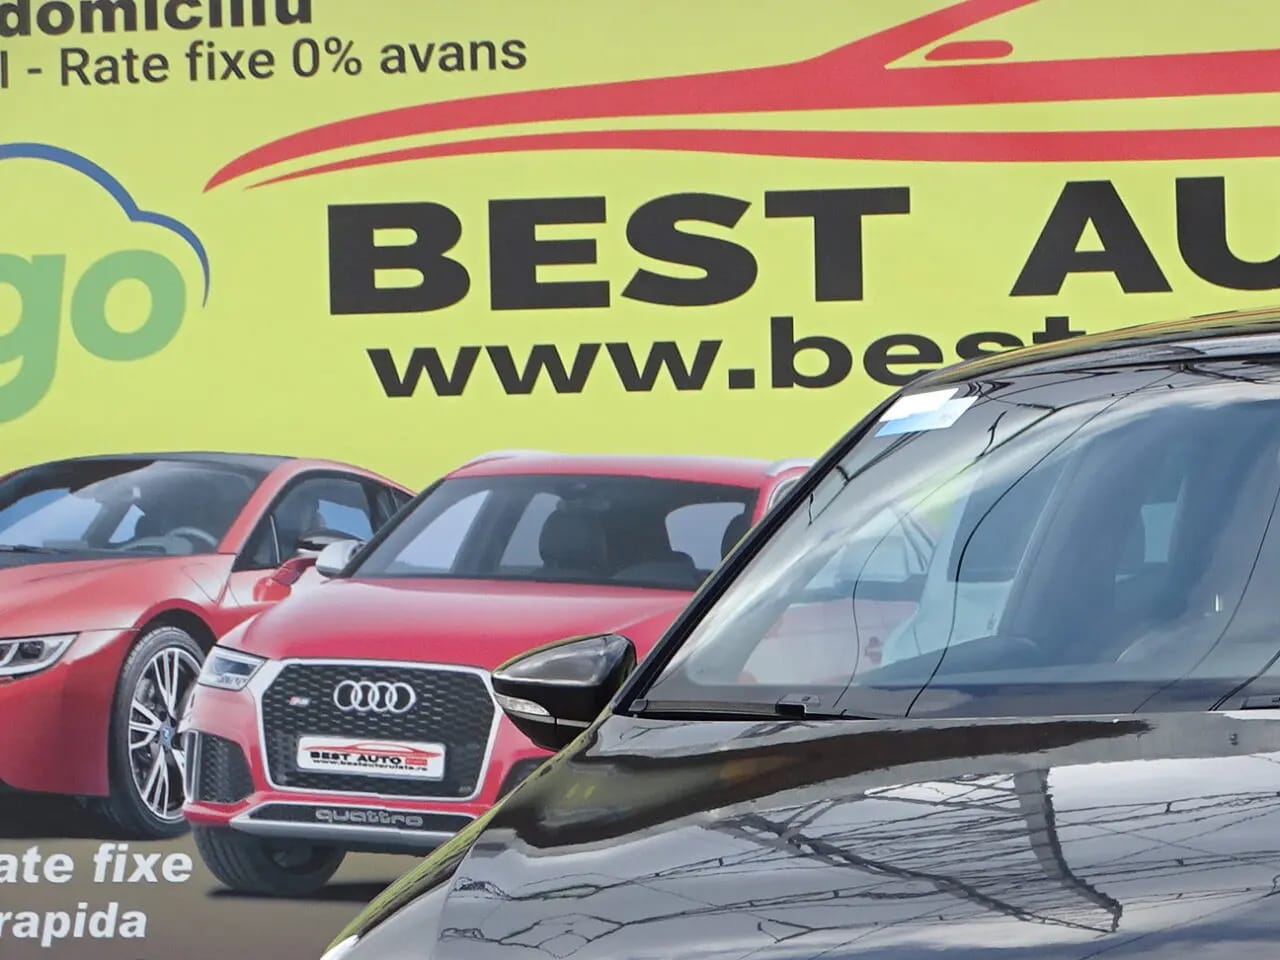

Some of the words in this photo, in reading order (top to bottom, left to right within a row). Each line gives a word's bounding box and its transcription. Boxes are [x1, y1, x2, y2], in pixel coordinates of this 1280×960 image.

[60, 46, 169, 86] Rate
[184, 40, 275, 81] fixe
[292, 37, 363, 77] 0%
[380, 37, 528, 74] avans
[327, 186, 911, 315] BEST
[315, 808, 424, 828] quattro
[94, 843, 193, 884] fixe
[0, 903, 147, 948] rapida
